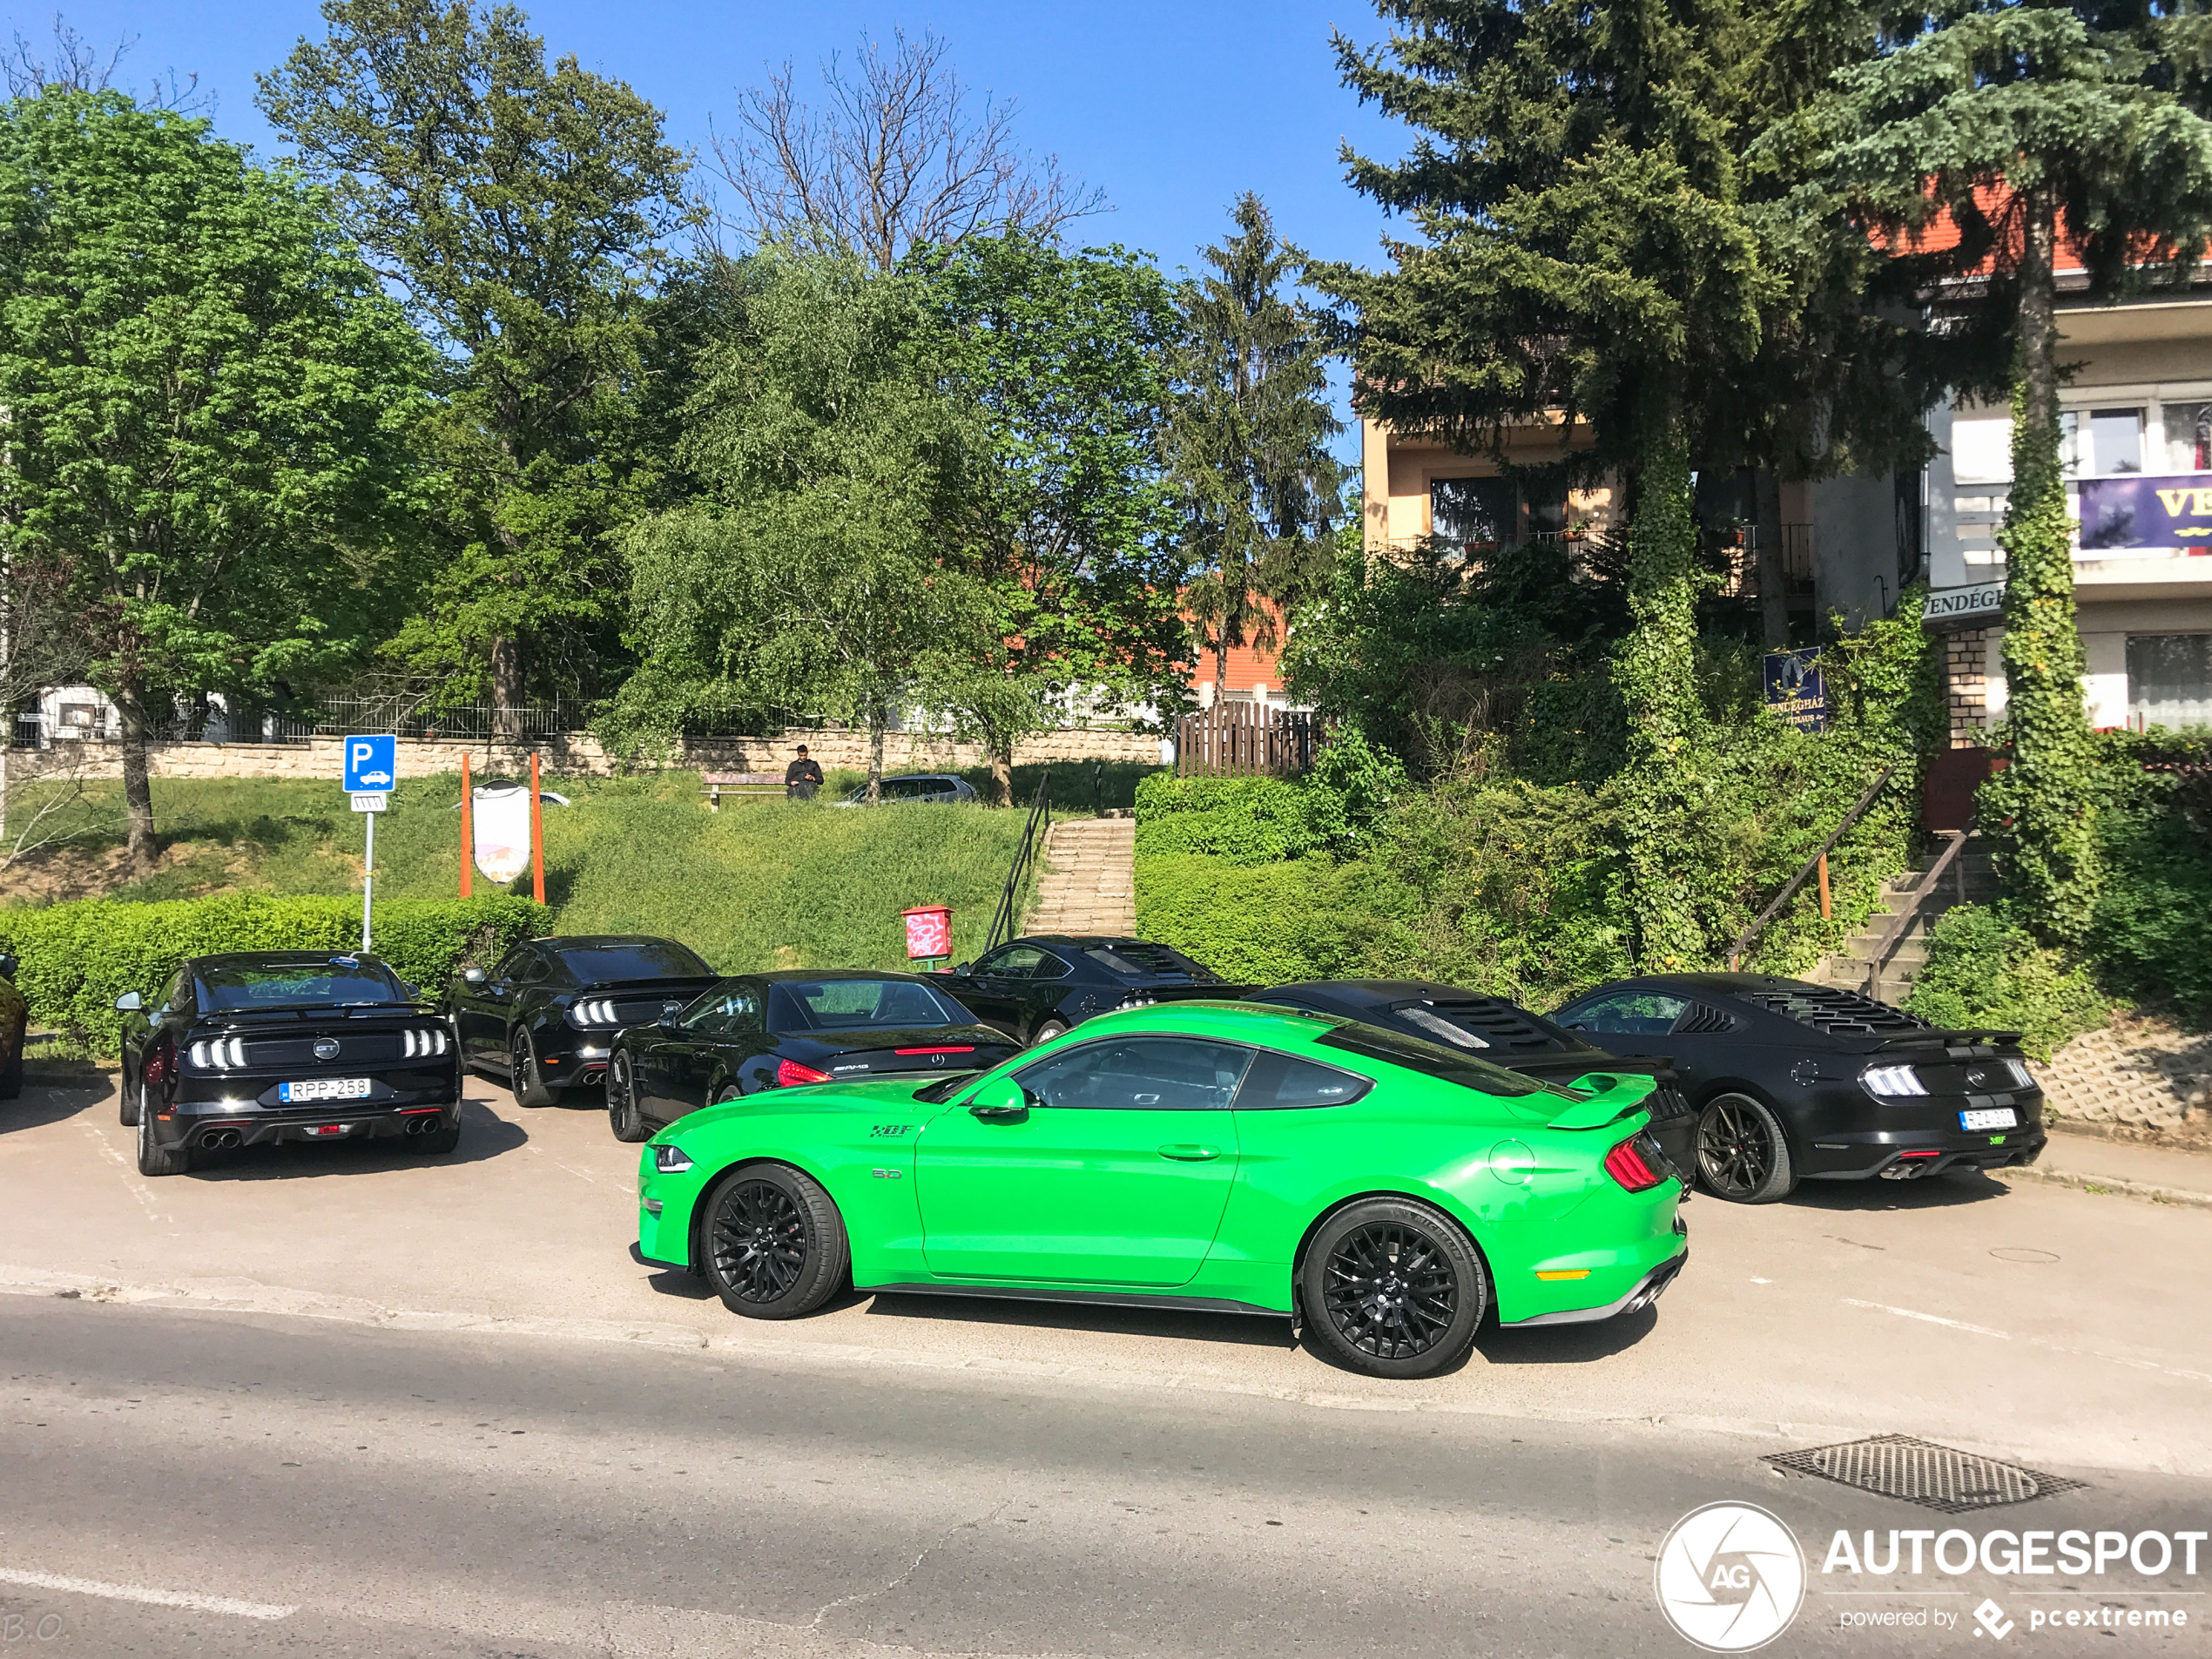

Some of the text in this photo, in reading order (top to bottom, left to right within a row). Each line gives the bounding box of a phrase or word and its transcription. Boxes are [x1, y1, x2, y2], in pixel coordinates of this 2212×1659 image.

[2155, 488, 2212, 517] VE
[352, 743, 373, 773] P
[293, 1080, 366, 1097] RPP-258
[872, 1168, 902, 1180] 5.0
[1414, 1215, 1462, 1258] MICHELIN
